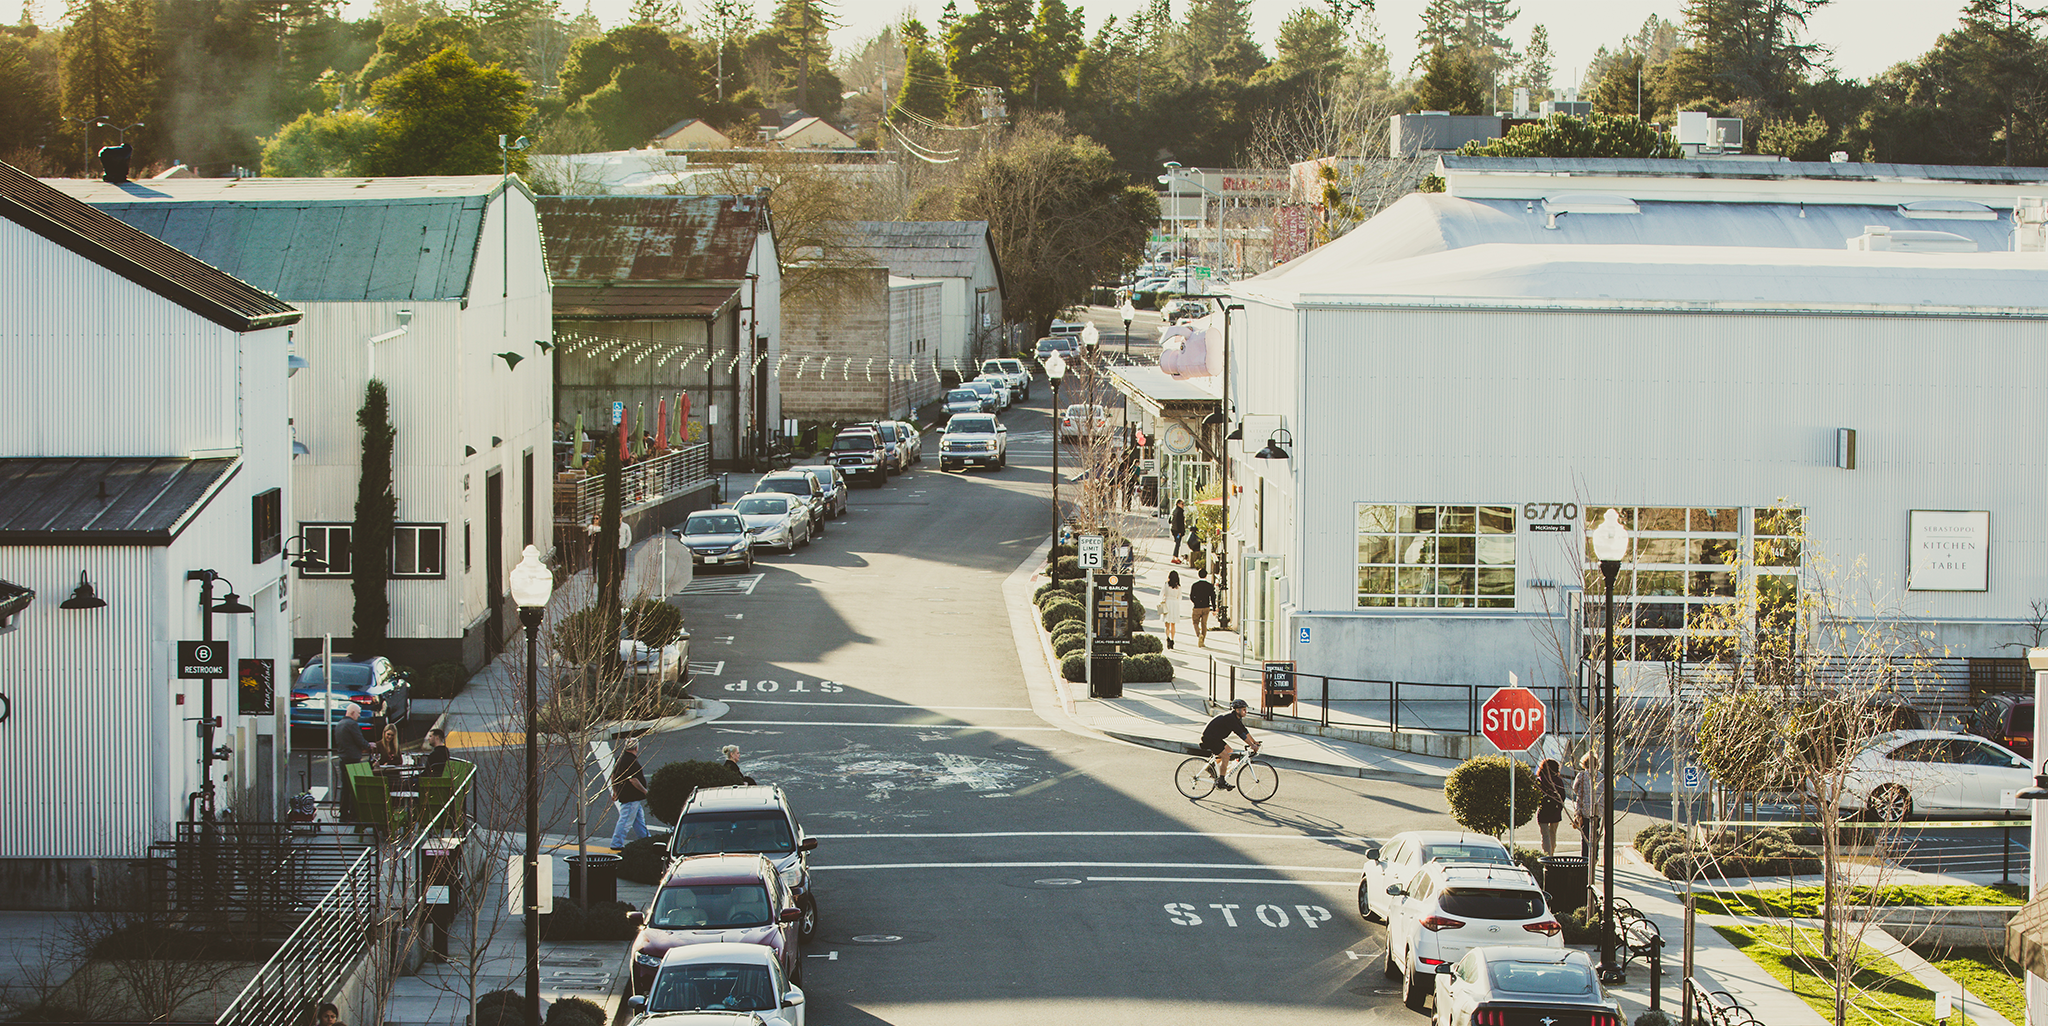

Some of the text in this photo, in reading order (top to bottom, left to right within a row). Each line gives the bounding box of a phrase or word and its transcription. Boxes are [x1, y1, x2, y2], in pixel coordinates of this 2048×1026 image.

[1524, 502, 1578, 520] 6770
[1923, 541, 1976, 550] KITCHEN
[1083, 552, 1099, 565] 15
[1931, 561, 1967, 570] TABLE
[184, 666, 223, 674] RESTROOMS
[724, 679, 844, 693] STOP
[1485, 708, 1542, 732] STOP
[1163, 902, 1333, 929] STOP
